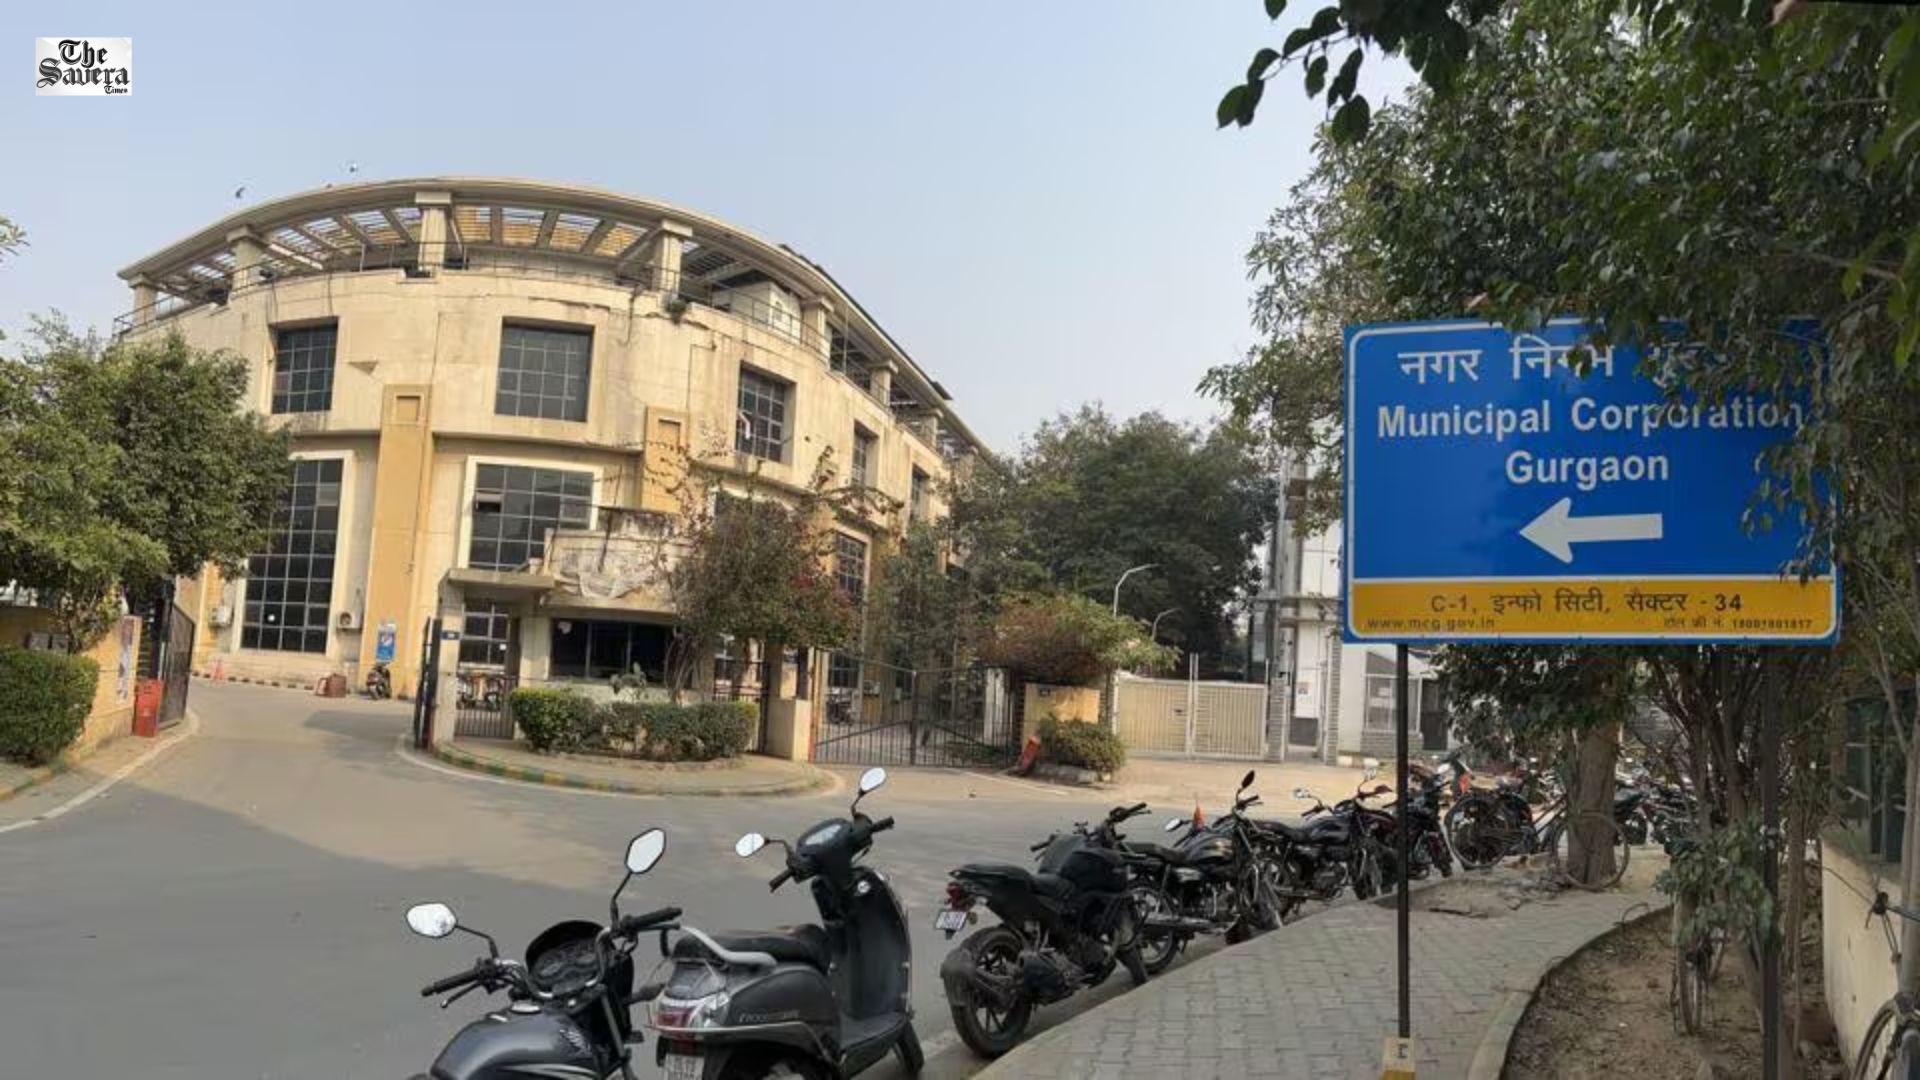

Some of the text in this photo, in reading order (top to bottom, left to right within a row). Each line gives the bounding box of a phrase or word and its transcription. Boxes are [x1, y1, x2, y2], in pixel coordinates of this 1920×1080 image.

[1397, 349, 1483, 384] नगर
[1378, 397, 1802, 442] Municipal Corporation
[1506, 450, 1669, 491] Gurgaon
[1431, 594, 1477, 614] C-1,
[1714, 593, 1742, 611] 34
